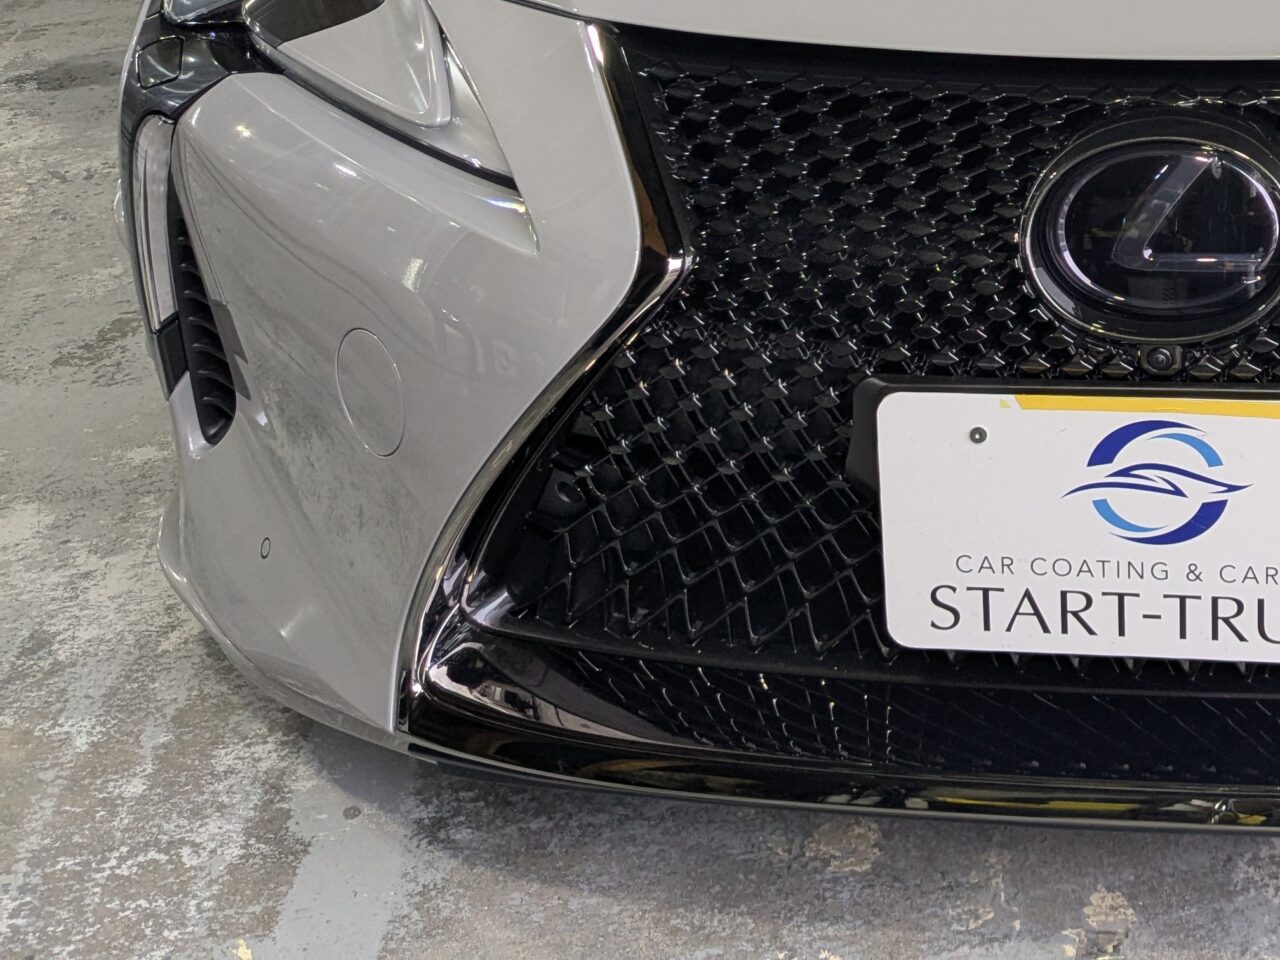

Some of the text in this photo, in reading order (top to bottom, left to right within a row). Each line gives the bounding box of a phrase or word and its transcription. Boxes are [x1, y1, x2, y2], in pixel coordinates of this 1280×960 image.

[955, 554, 1015, 575] CAR
[1029, 557, 1170, 581] COATING
[1185, 563, 1204, 583] &
[1218, 564, 1280, 586] CAR
